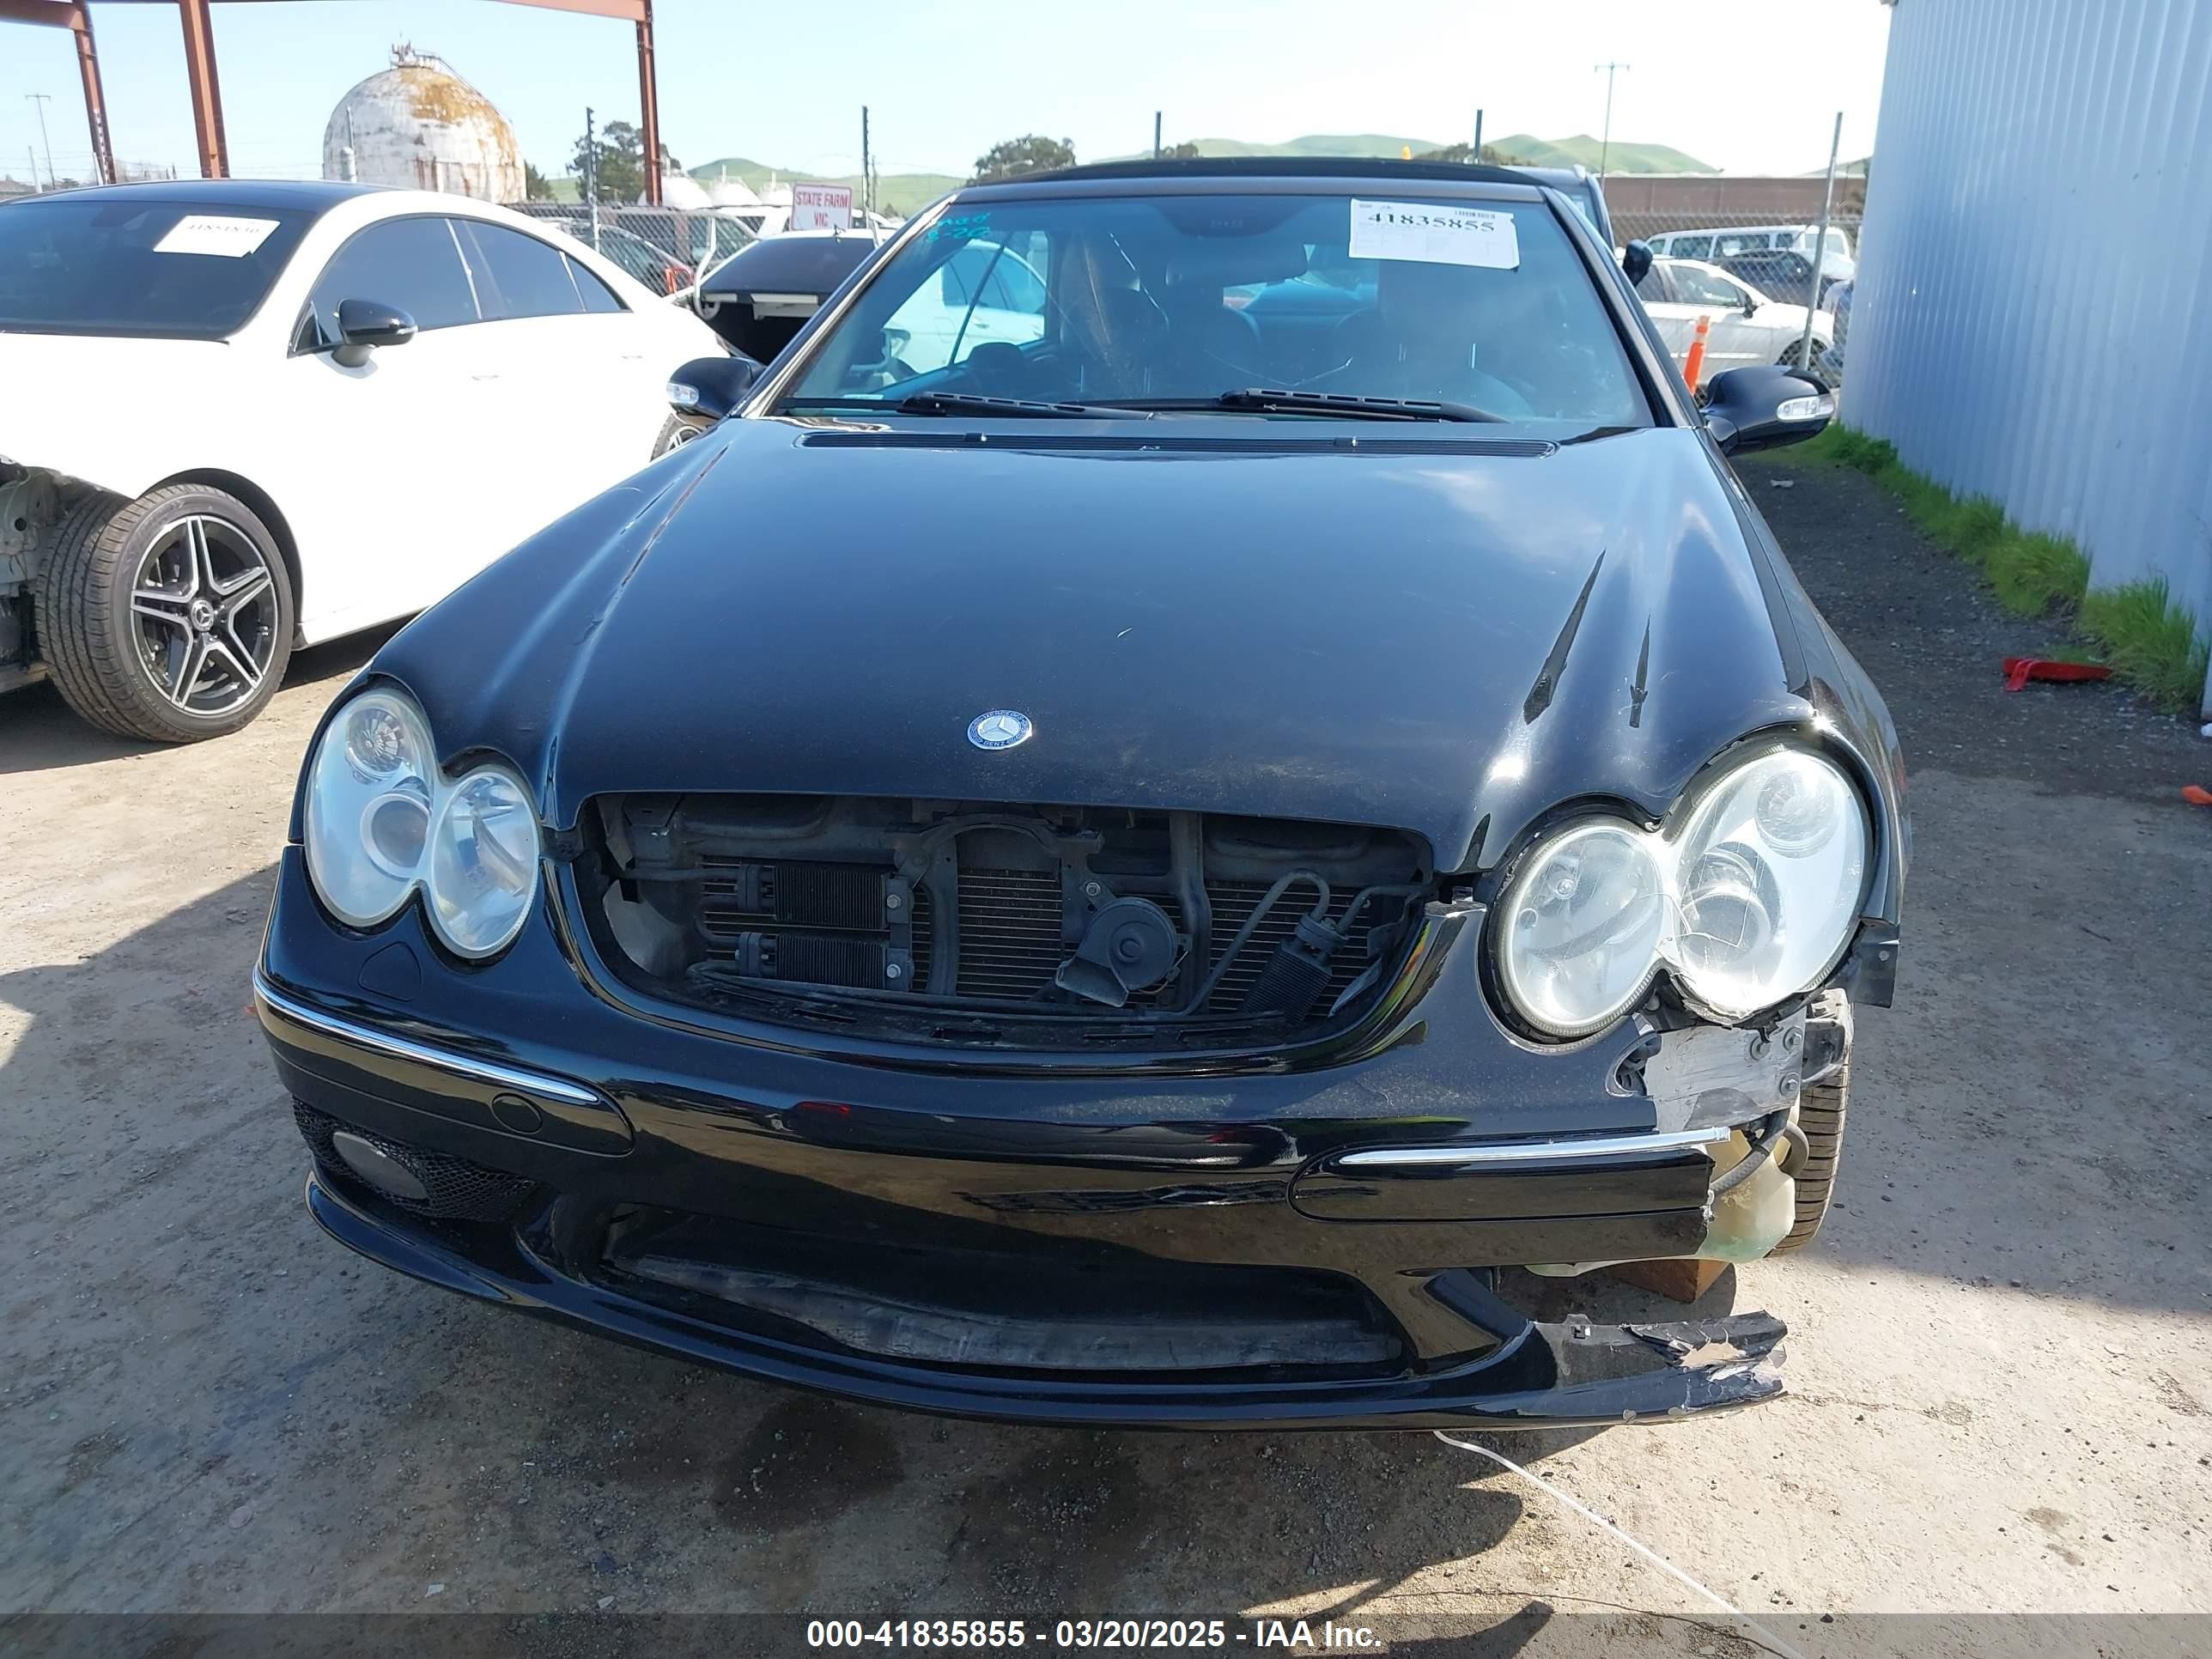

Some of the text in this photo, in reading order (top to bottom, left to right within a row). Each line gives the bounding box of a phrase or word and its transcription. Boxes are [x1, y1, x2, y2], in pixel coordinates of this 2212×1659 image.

[796, 191, 848, 208] STATE FARM
[1368, 213, 1495, 232] 41835855
